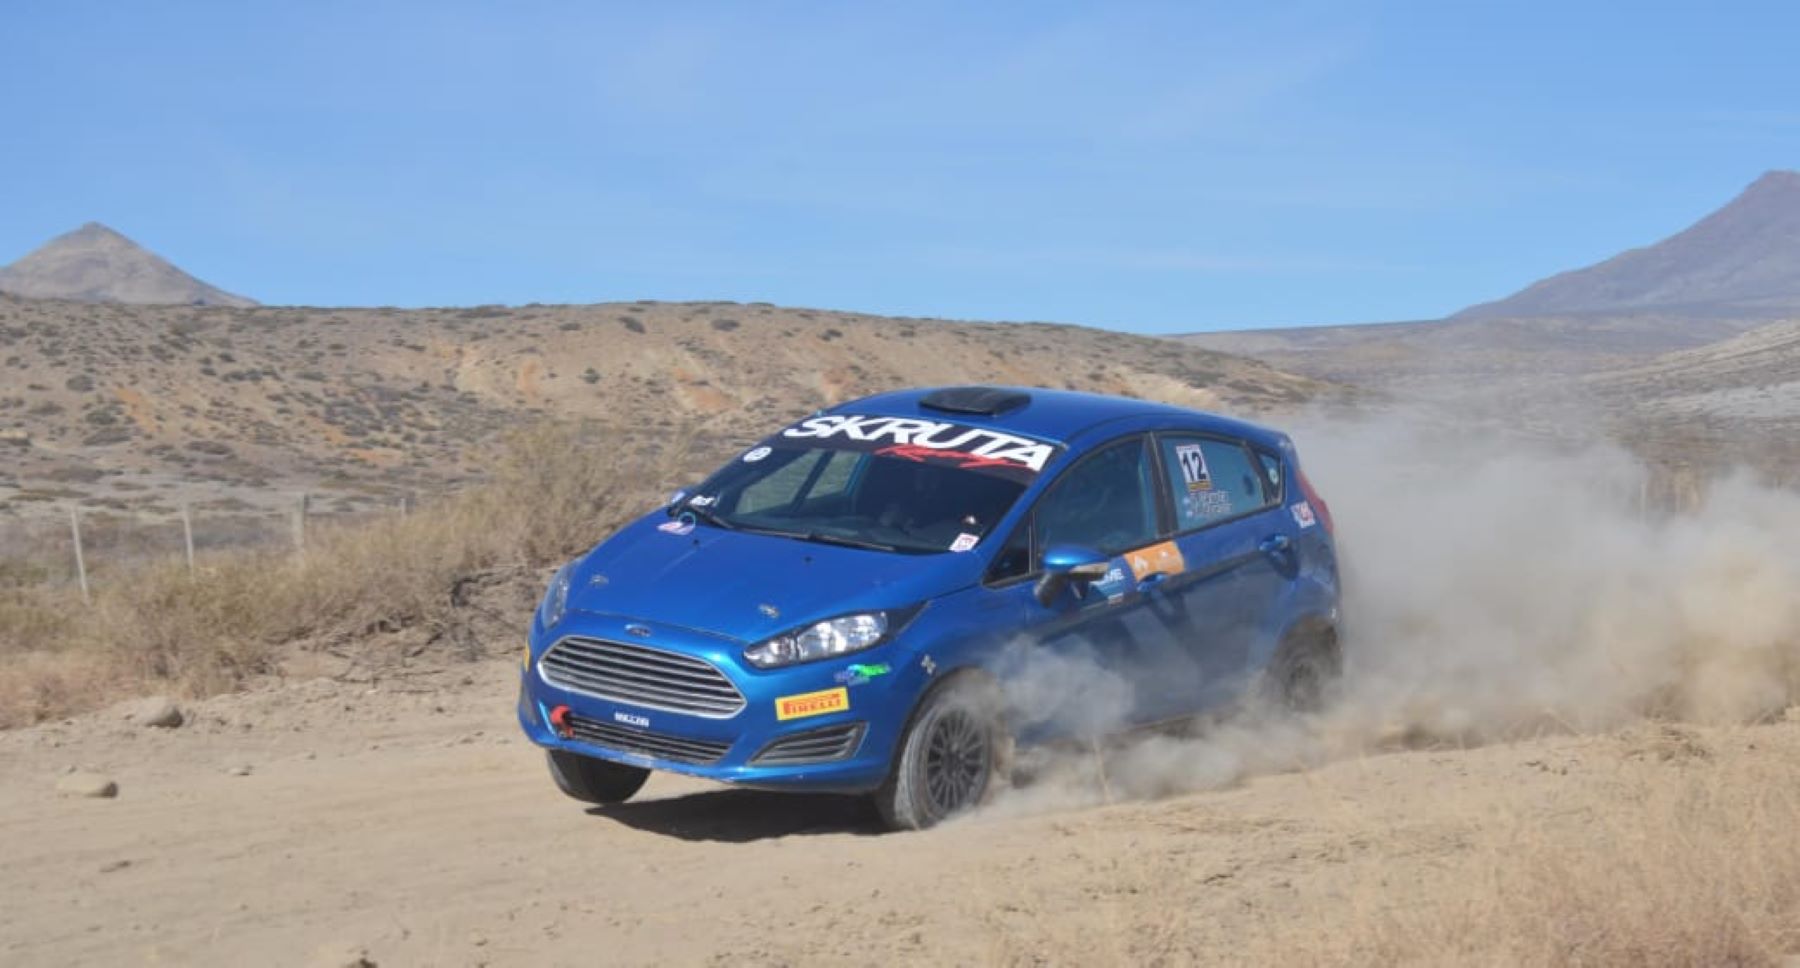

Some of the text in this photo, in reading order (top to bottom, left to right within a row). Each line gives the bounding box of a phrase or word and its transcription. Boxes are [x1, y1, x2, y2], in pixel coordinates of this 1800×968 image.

[783, 416, 1053, 472] SKRUTA
[1182, 452, 1207, 481] 12
[783, 693, 842, 716] PIRELLI
